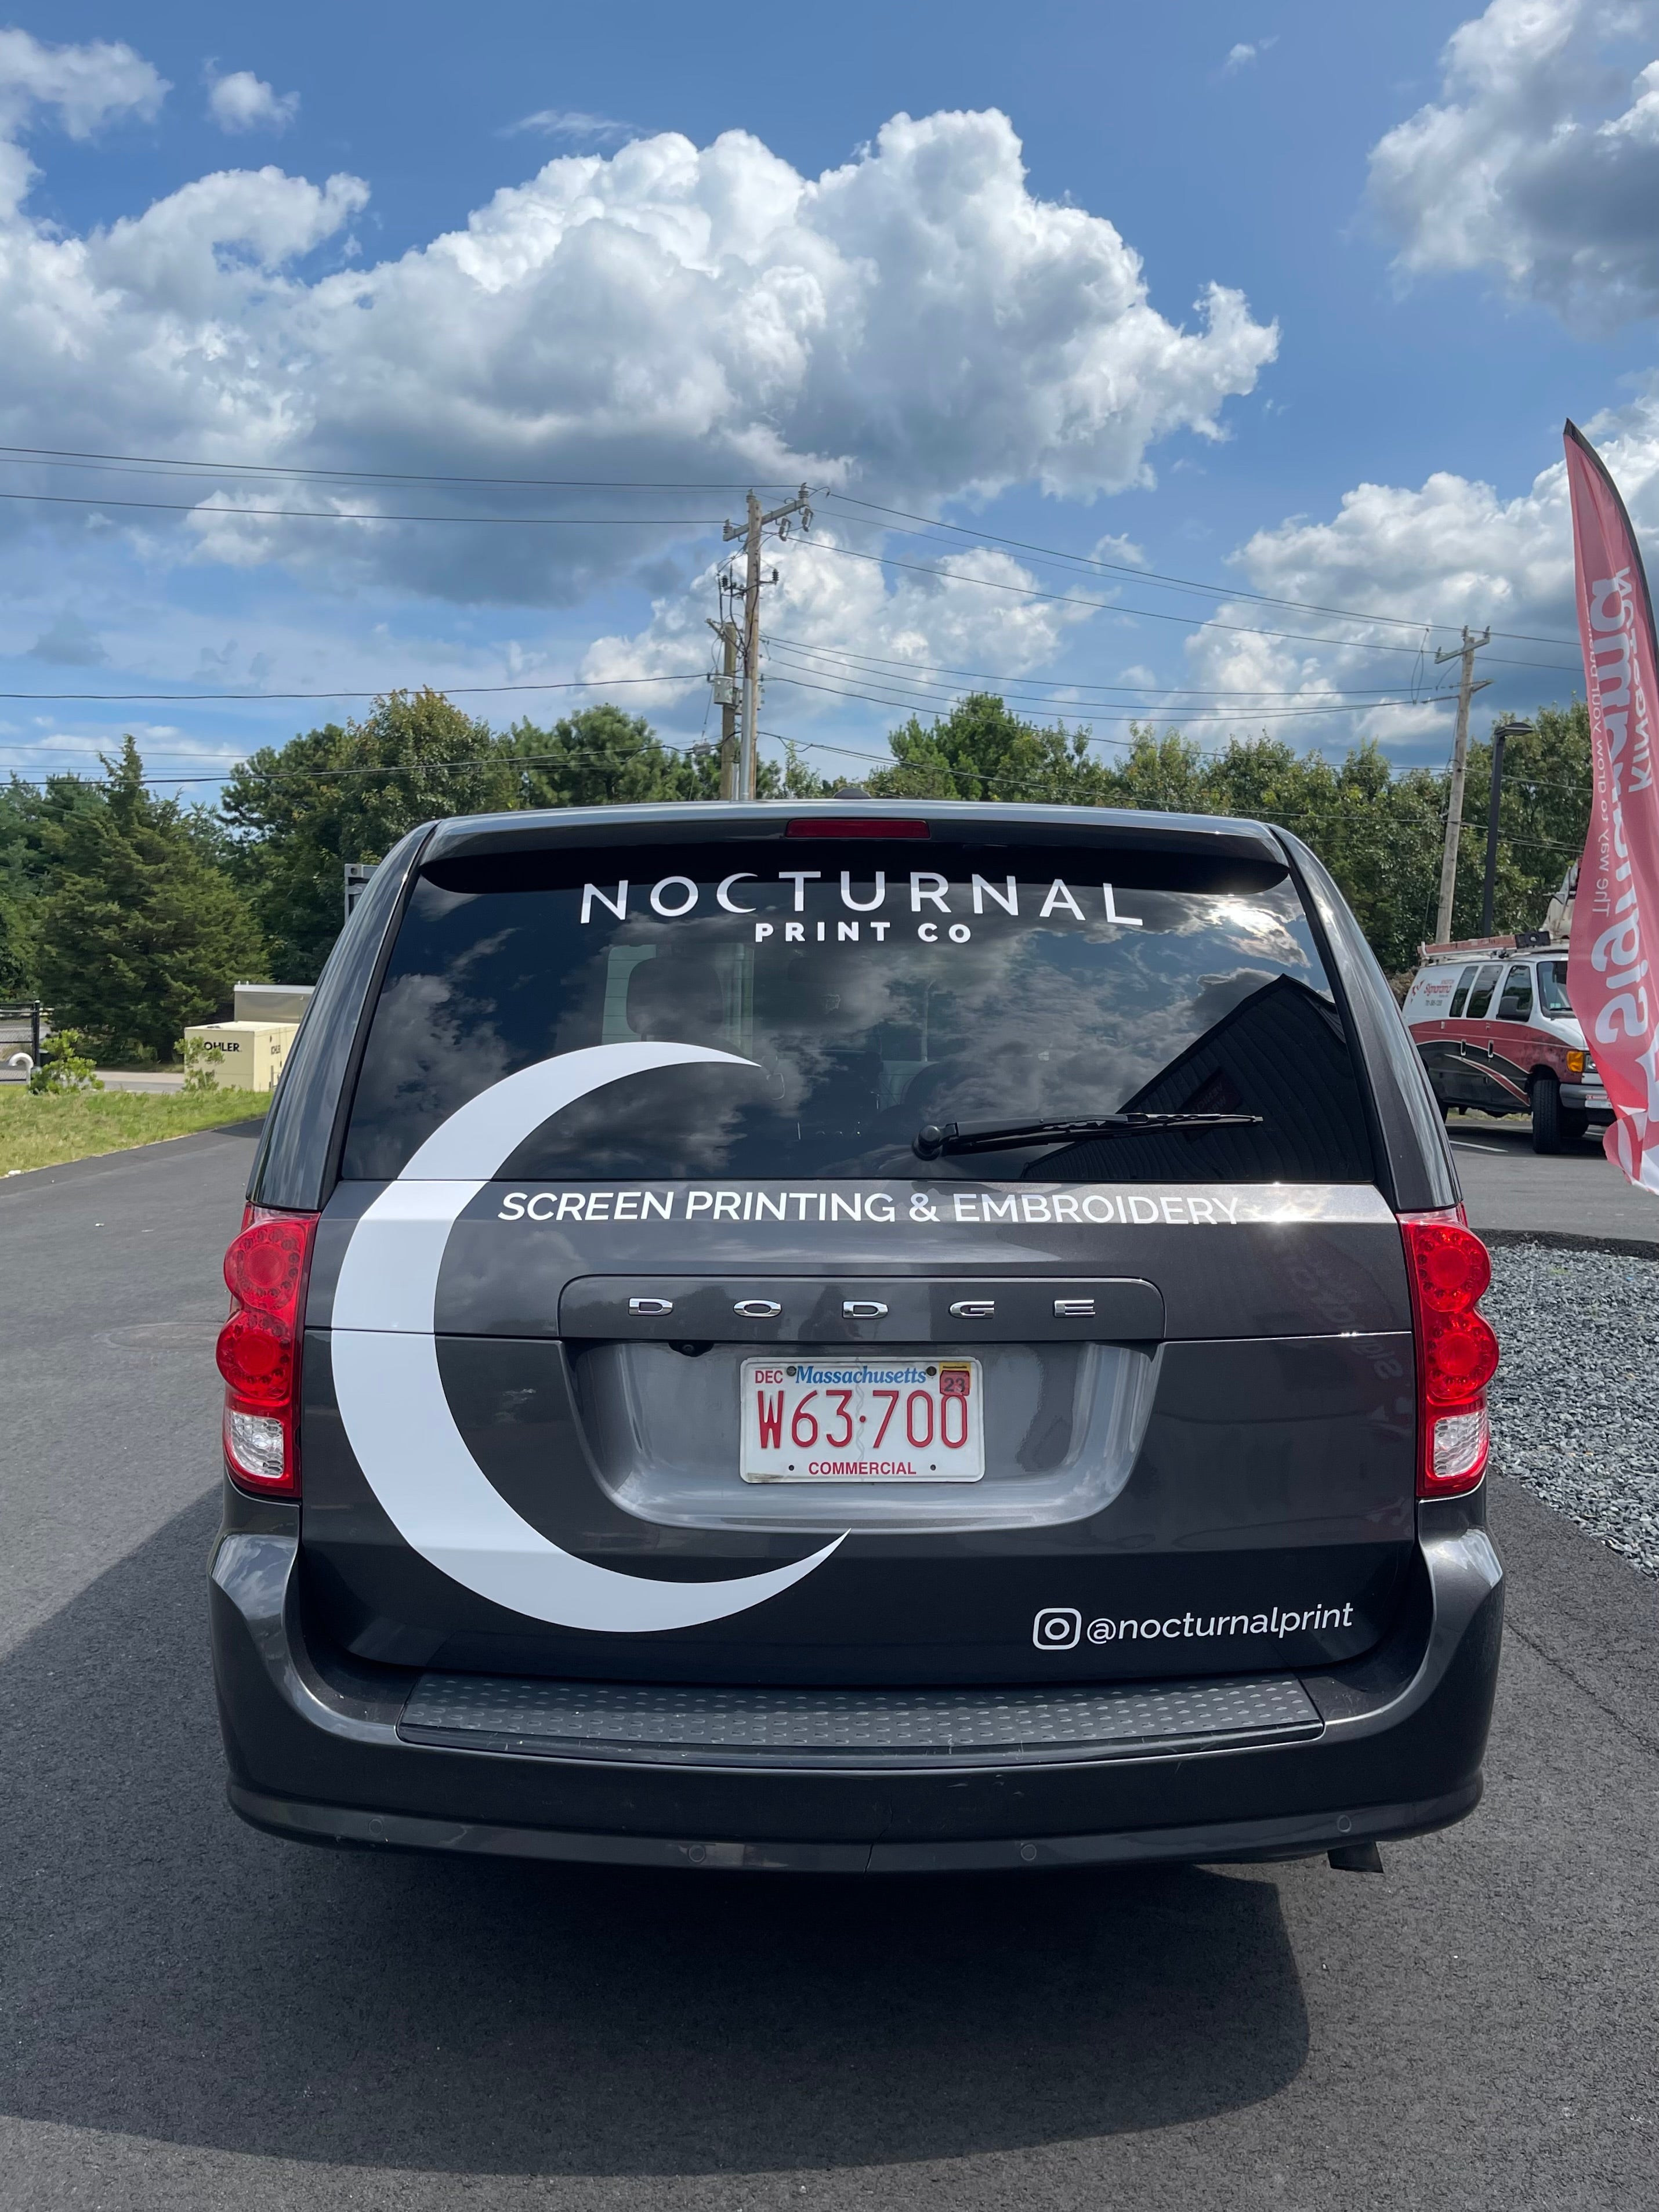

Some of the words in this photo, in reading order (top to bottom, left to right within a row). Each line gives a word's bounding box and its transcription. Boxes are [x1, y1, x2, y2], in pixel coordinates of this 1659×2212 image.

[581, 871, 1143, 926] NOCTURNAL
[755, 922, 890, 942] PRINT
[918, 923, 972, 944] CO
[203, 1042, 240, 1052] OHLER
[497, 1191, 674, 1221] SCREEN
[685, 1191, 896, 1222] PRINTING
[908, 1192, 941, 1221] &
[953, 1193, 1239, 1225] EMBROIDERY
[628, 1297, 1096, 1319] DODGE
[755, 1370, 783, 1384] DEC
[795, 1365, 926, 1384] Massachusetts
[809, 1462, 917, 1475] COMMERCIAL
[1086, 1602, 1354, 1644] @nocturnalprint
